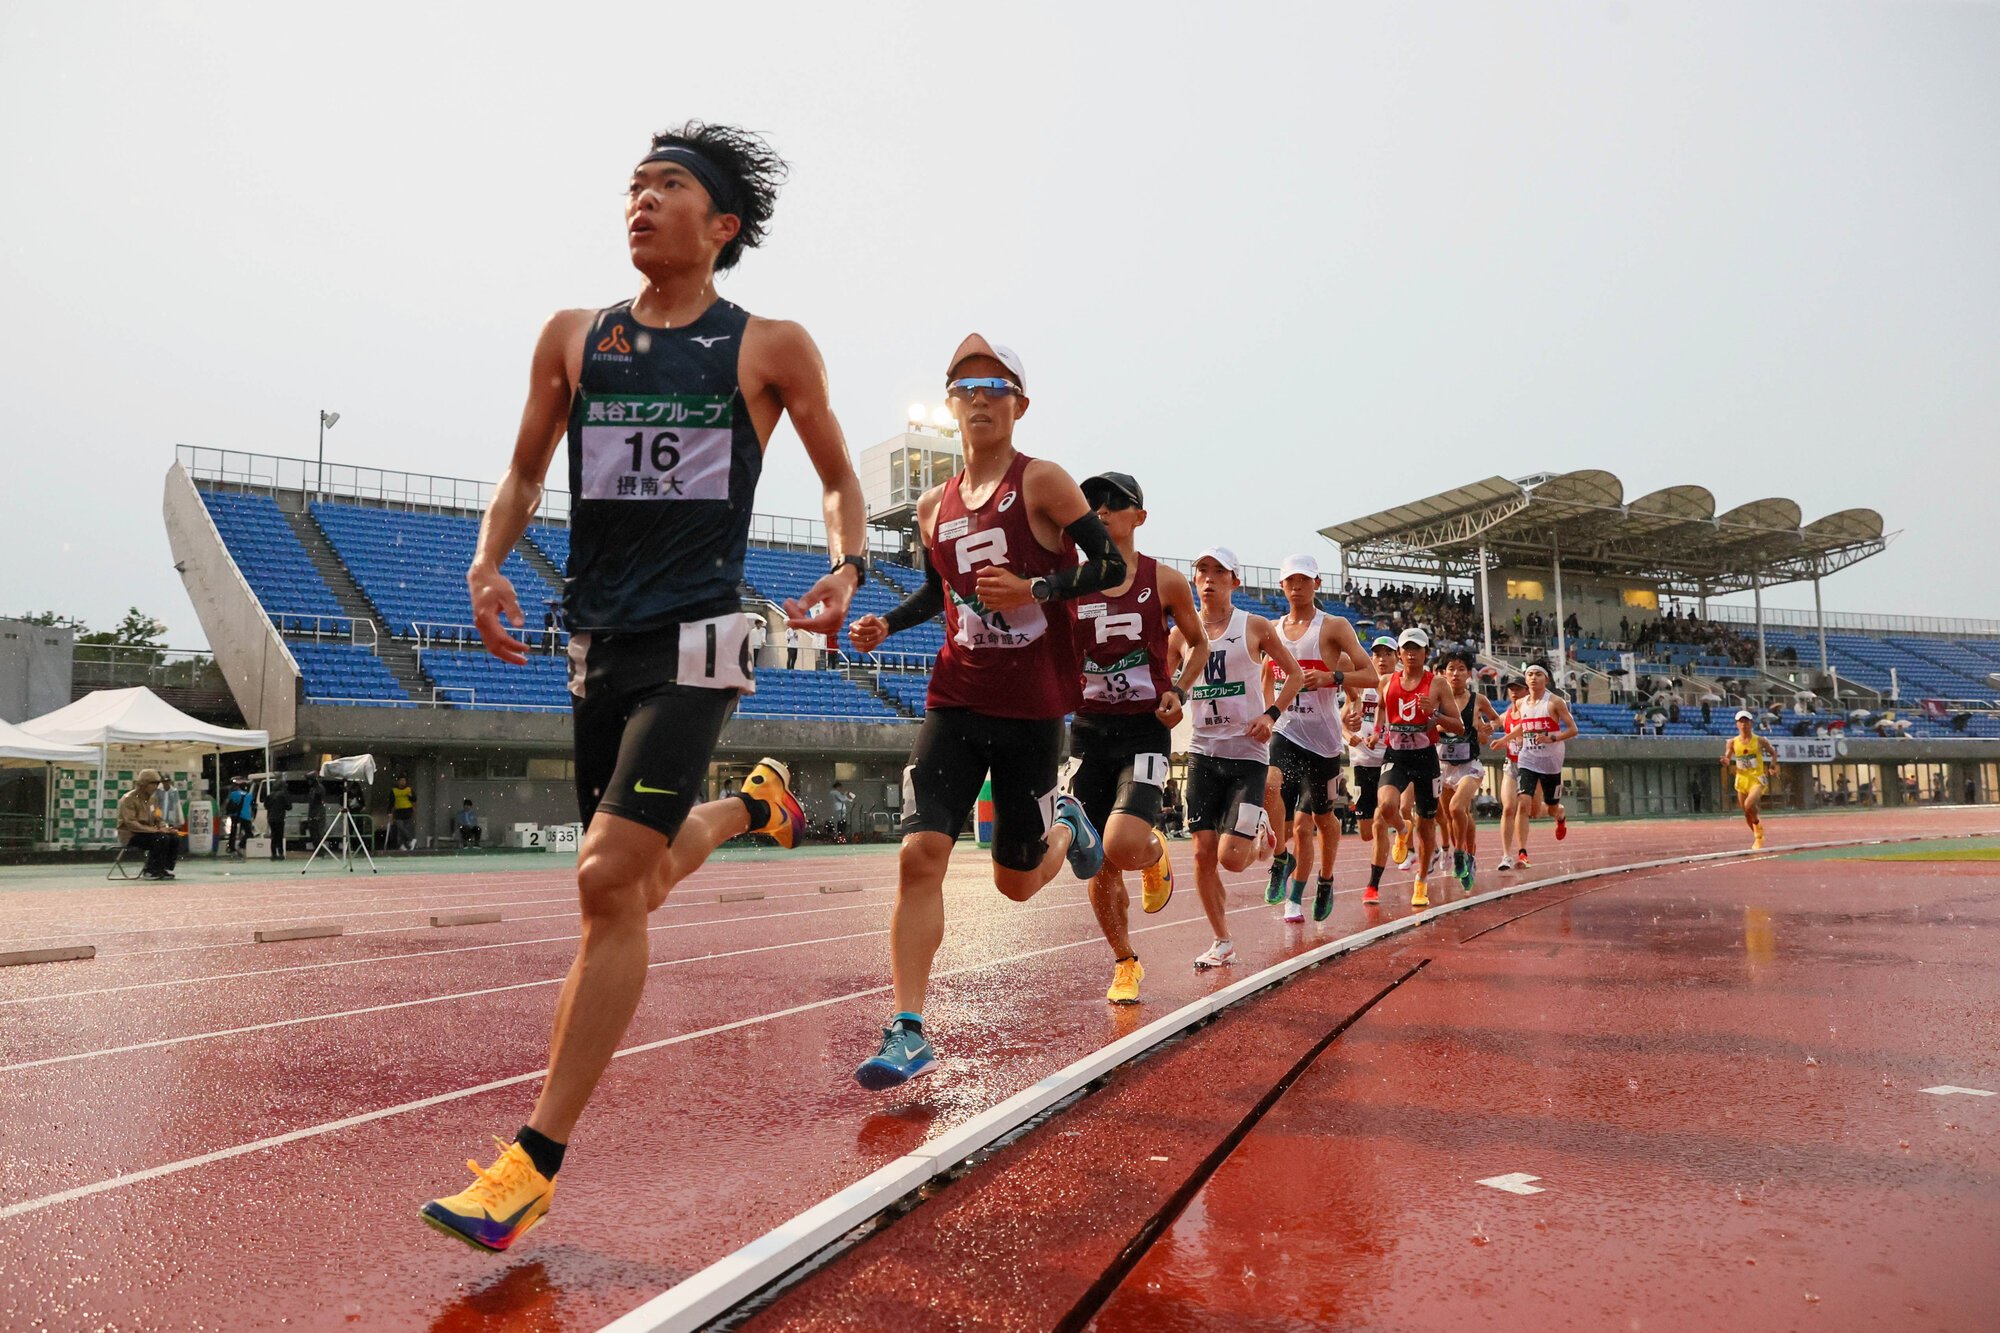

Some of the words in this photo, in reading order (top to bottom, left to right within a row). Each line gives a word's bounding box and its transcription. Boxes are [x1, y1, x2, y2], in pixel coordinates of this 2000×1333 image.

[592, 353, 632, 363] SETSUDAI
[587, 401, 727, 424] 長谷工グループ
[625, 432, 680, 472] 16
[616, 475, 684, 496] 摂南大
[955, 527, 1010, 574] R
[1094, 612, 1142, 644] R
[1104, 673, 1130, 693] 13
[1209, 699, 1218, 715] 1
[1205, 716, 1231, 725] 関西大
[1401, 733, 1416, 743] 21
[1447, 745, 1455, 753] 5
[530, 833, 539, 845] 2
[559, 831, 573, 841] 35
